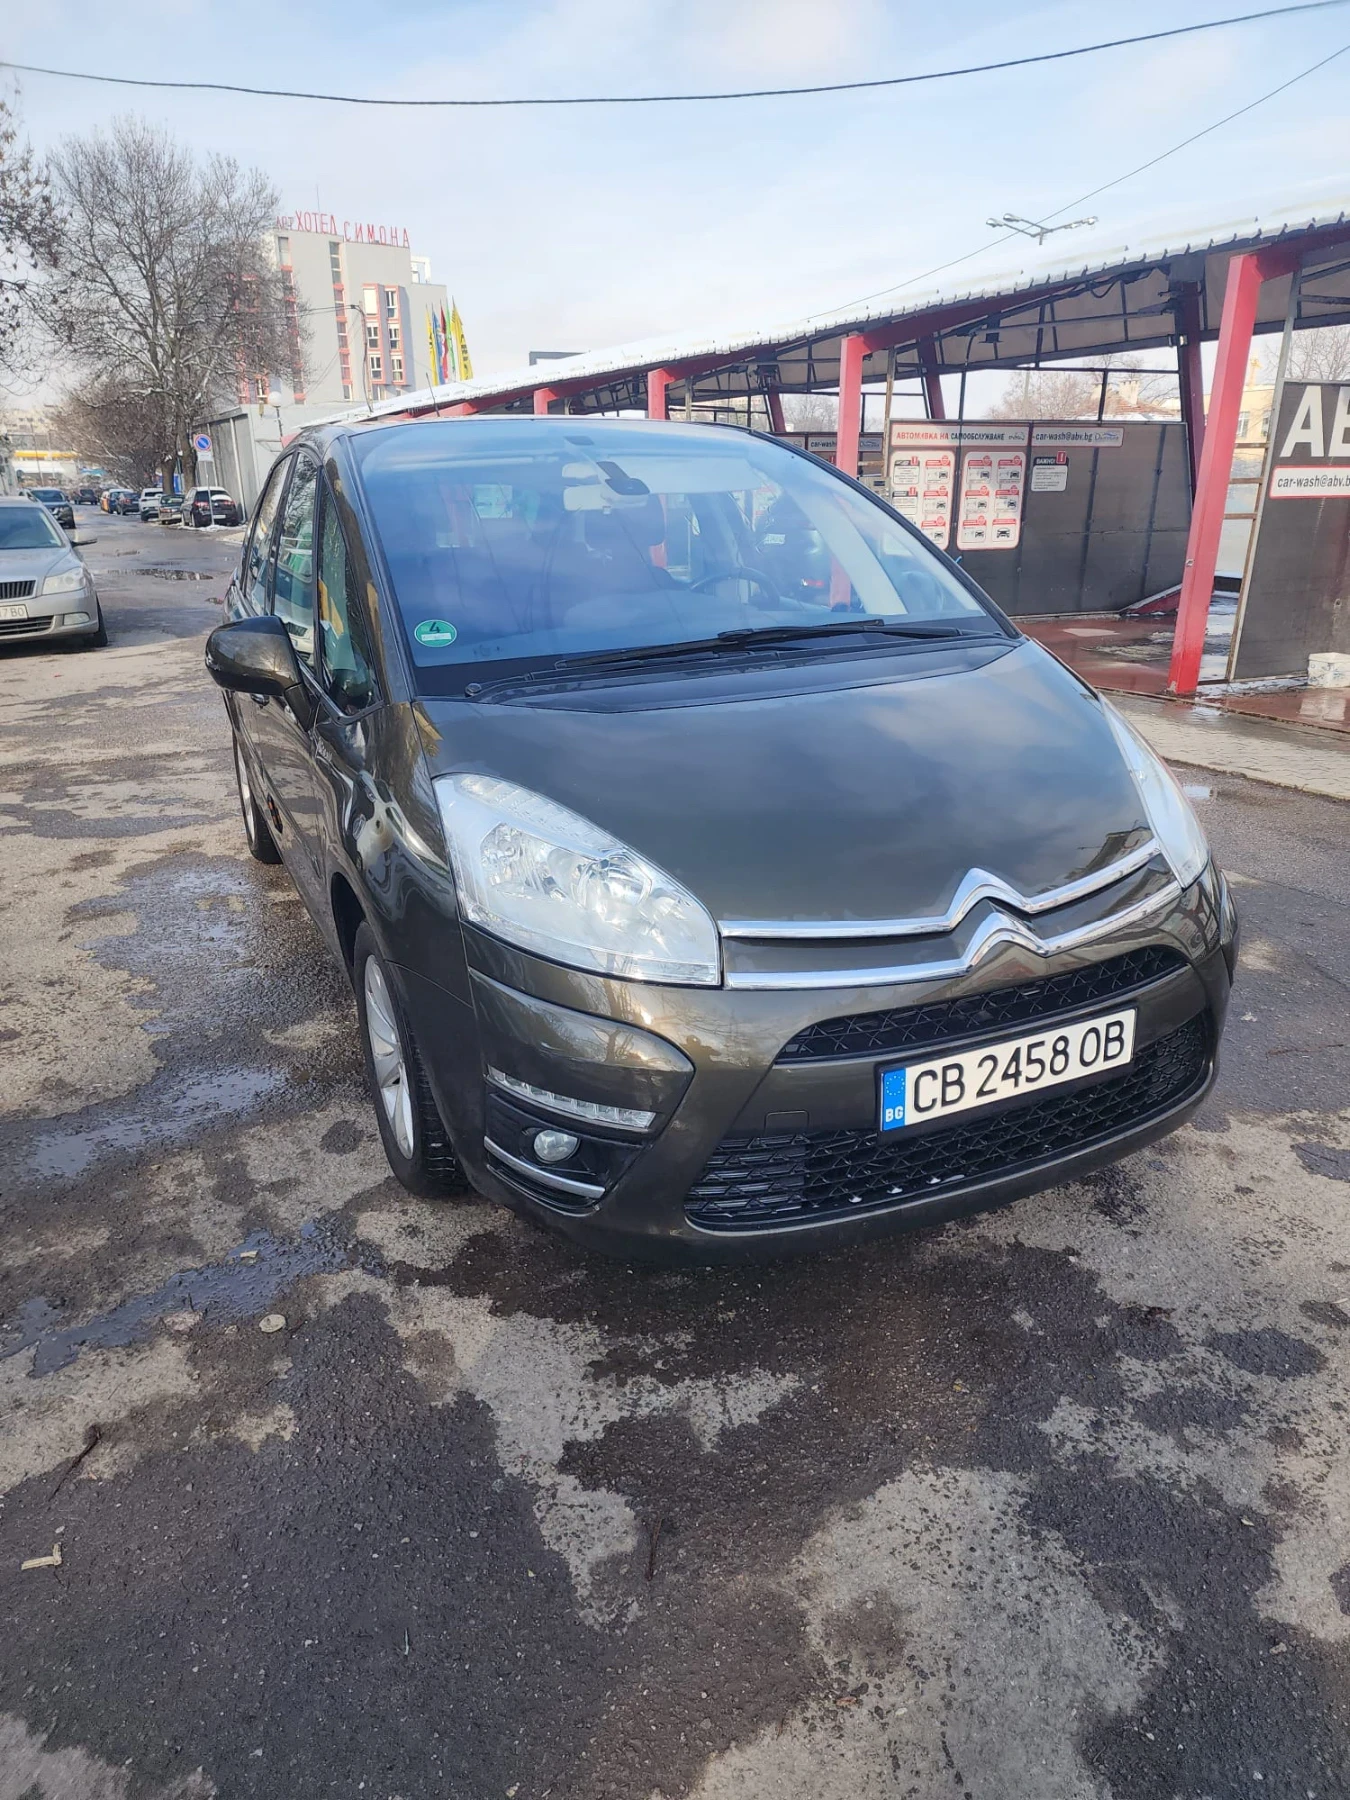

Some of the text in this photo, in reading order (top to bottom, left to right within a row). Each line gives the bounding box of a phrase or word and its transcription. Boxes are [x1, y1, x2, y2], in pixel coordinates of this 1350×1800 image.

[295, 210, 338, 235] ХОТЕЛ
[343, 220, 410, 248] СИМОНА
[940, 432, 949, 440] НА
[1035, 432, 1093, 442] car-wash@abv.bg
[429, 621, 442, 634] 4
[913, 1020, 1126, 1113] CB 2458 OB
[885, 1106, 904, 1123] BG
